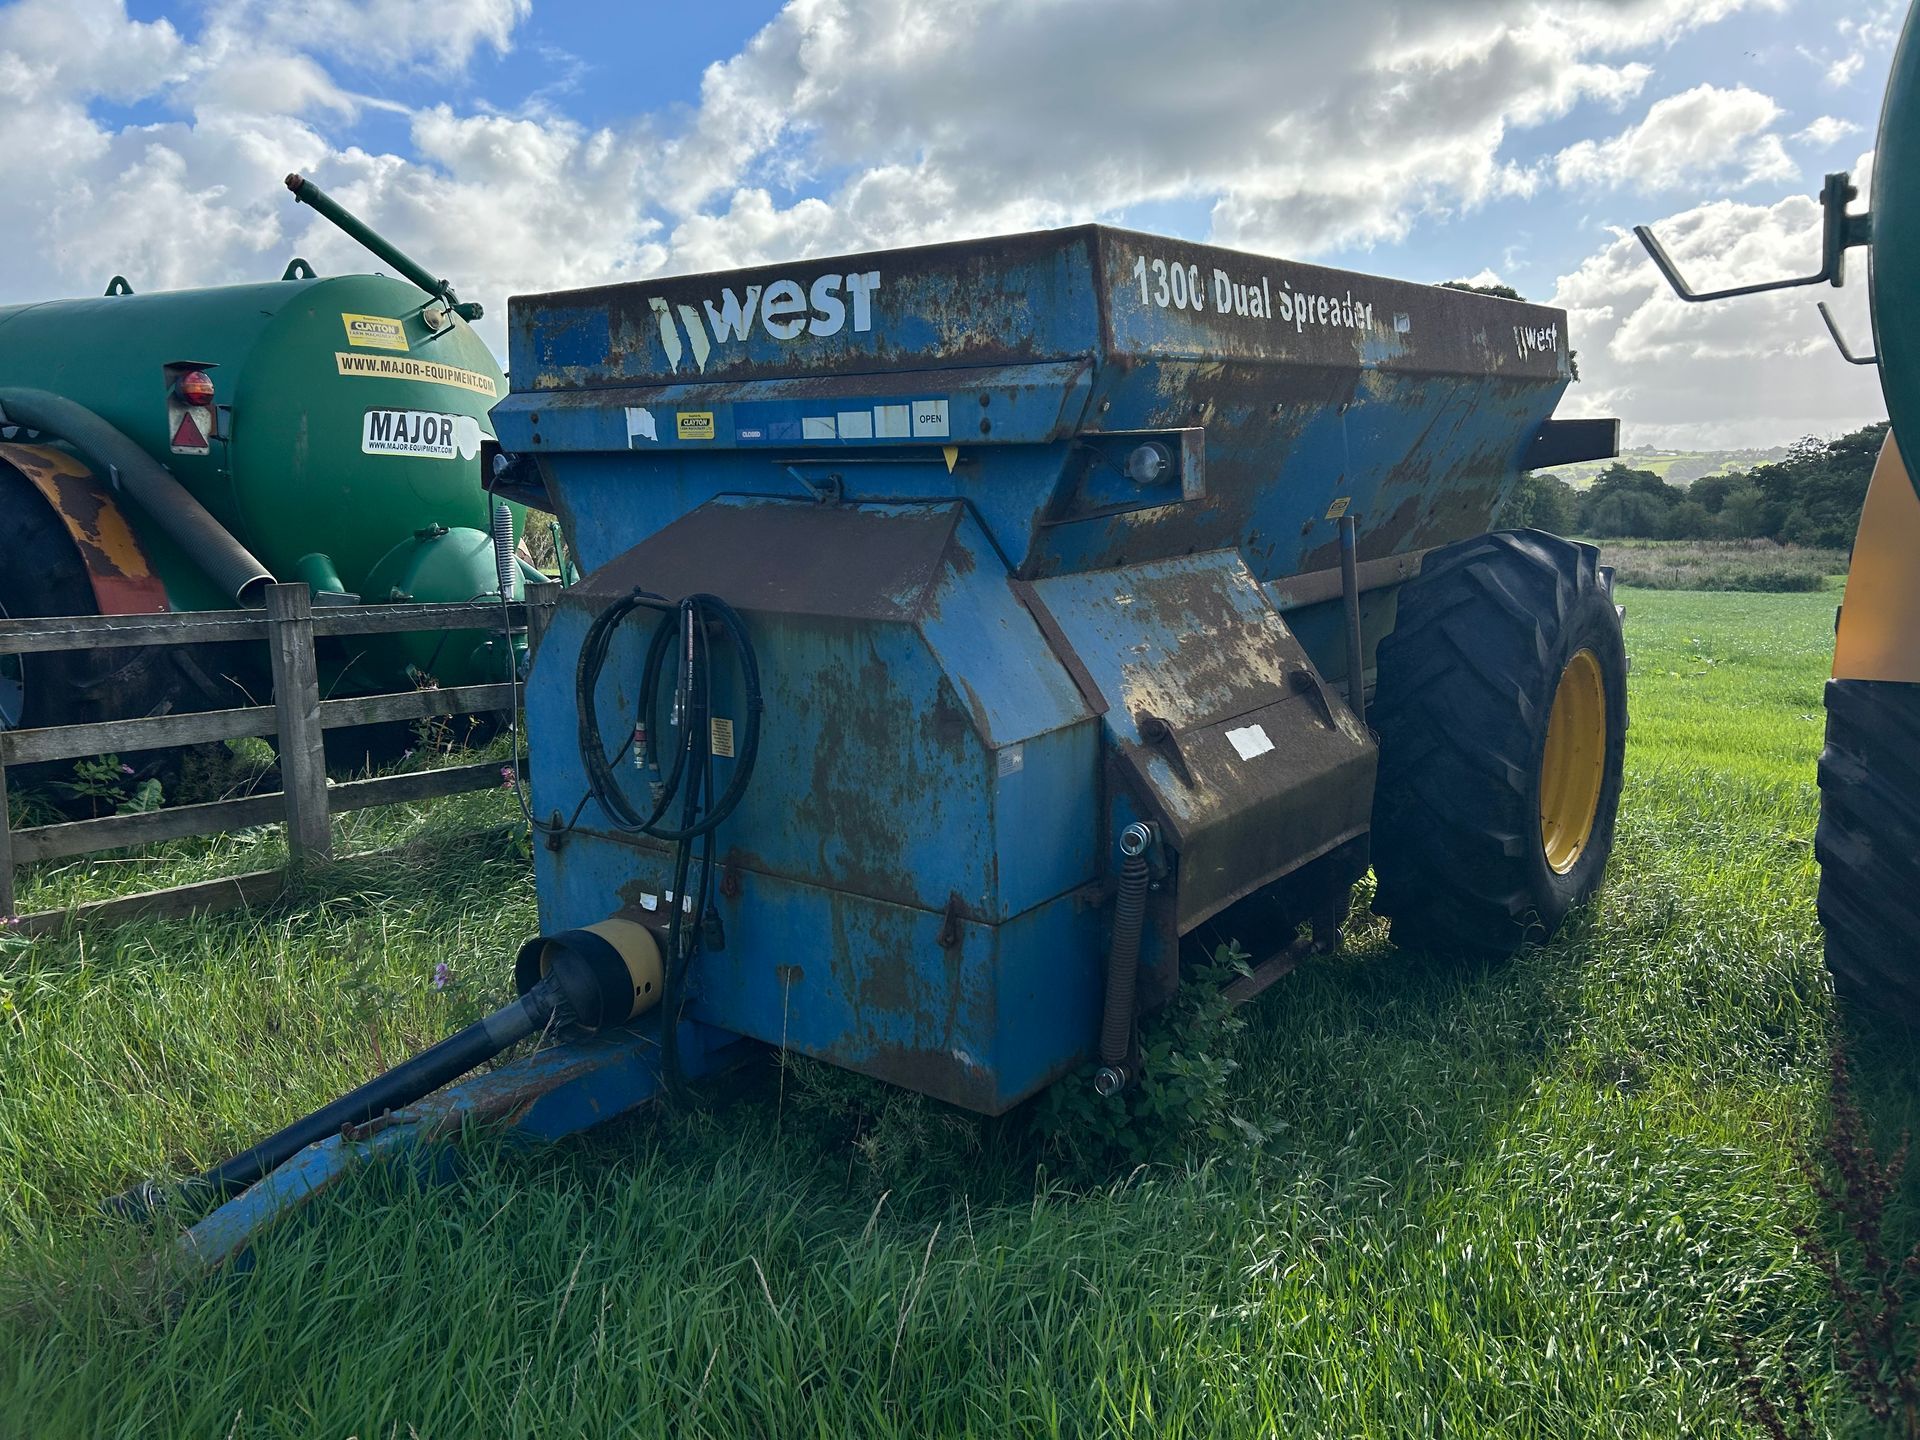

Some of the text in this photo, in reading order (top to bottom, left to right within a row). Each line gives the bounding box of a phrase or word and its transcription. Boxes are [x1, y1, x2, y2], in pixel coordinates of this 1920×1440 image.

[1133, 255, 1373, 333] 1300 Dual Spreader
[355, 322, 396, 334] CLAYTON
[341, 356, 495, 393] WWW.MAJOR-EQUIPMENT.COM
[369, 412, 453, 447] MAJOR
[919, 414, 942, 424] OPEN
[368, 441, 453, 455] WWW.MAJOR-EQUIPMENT.COM
